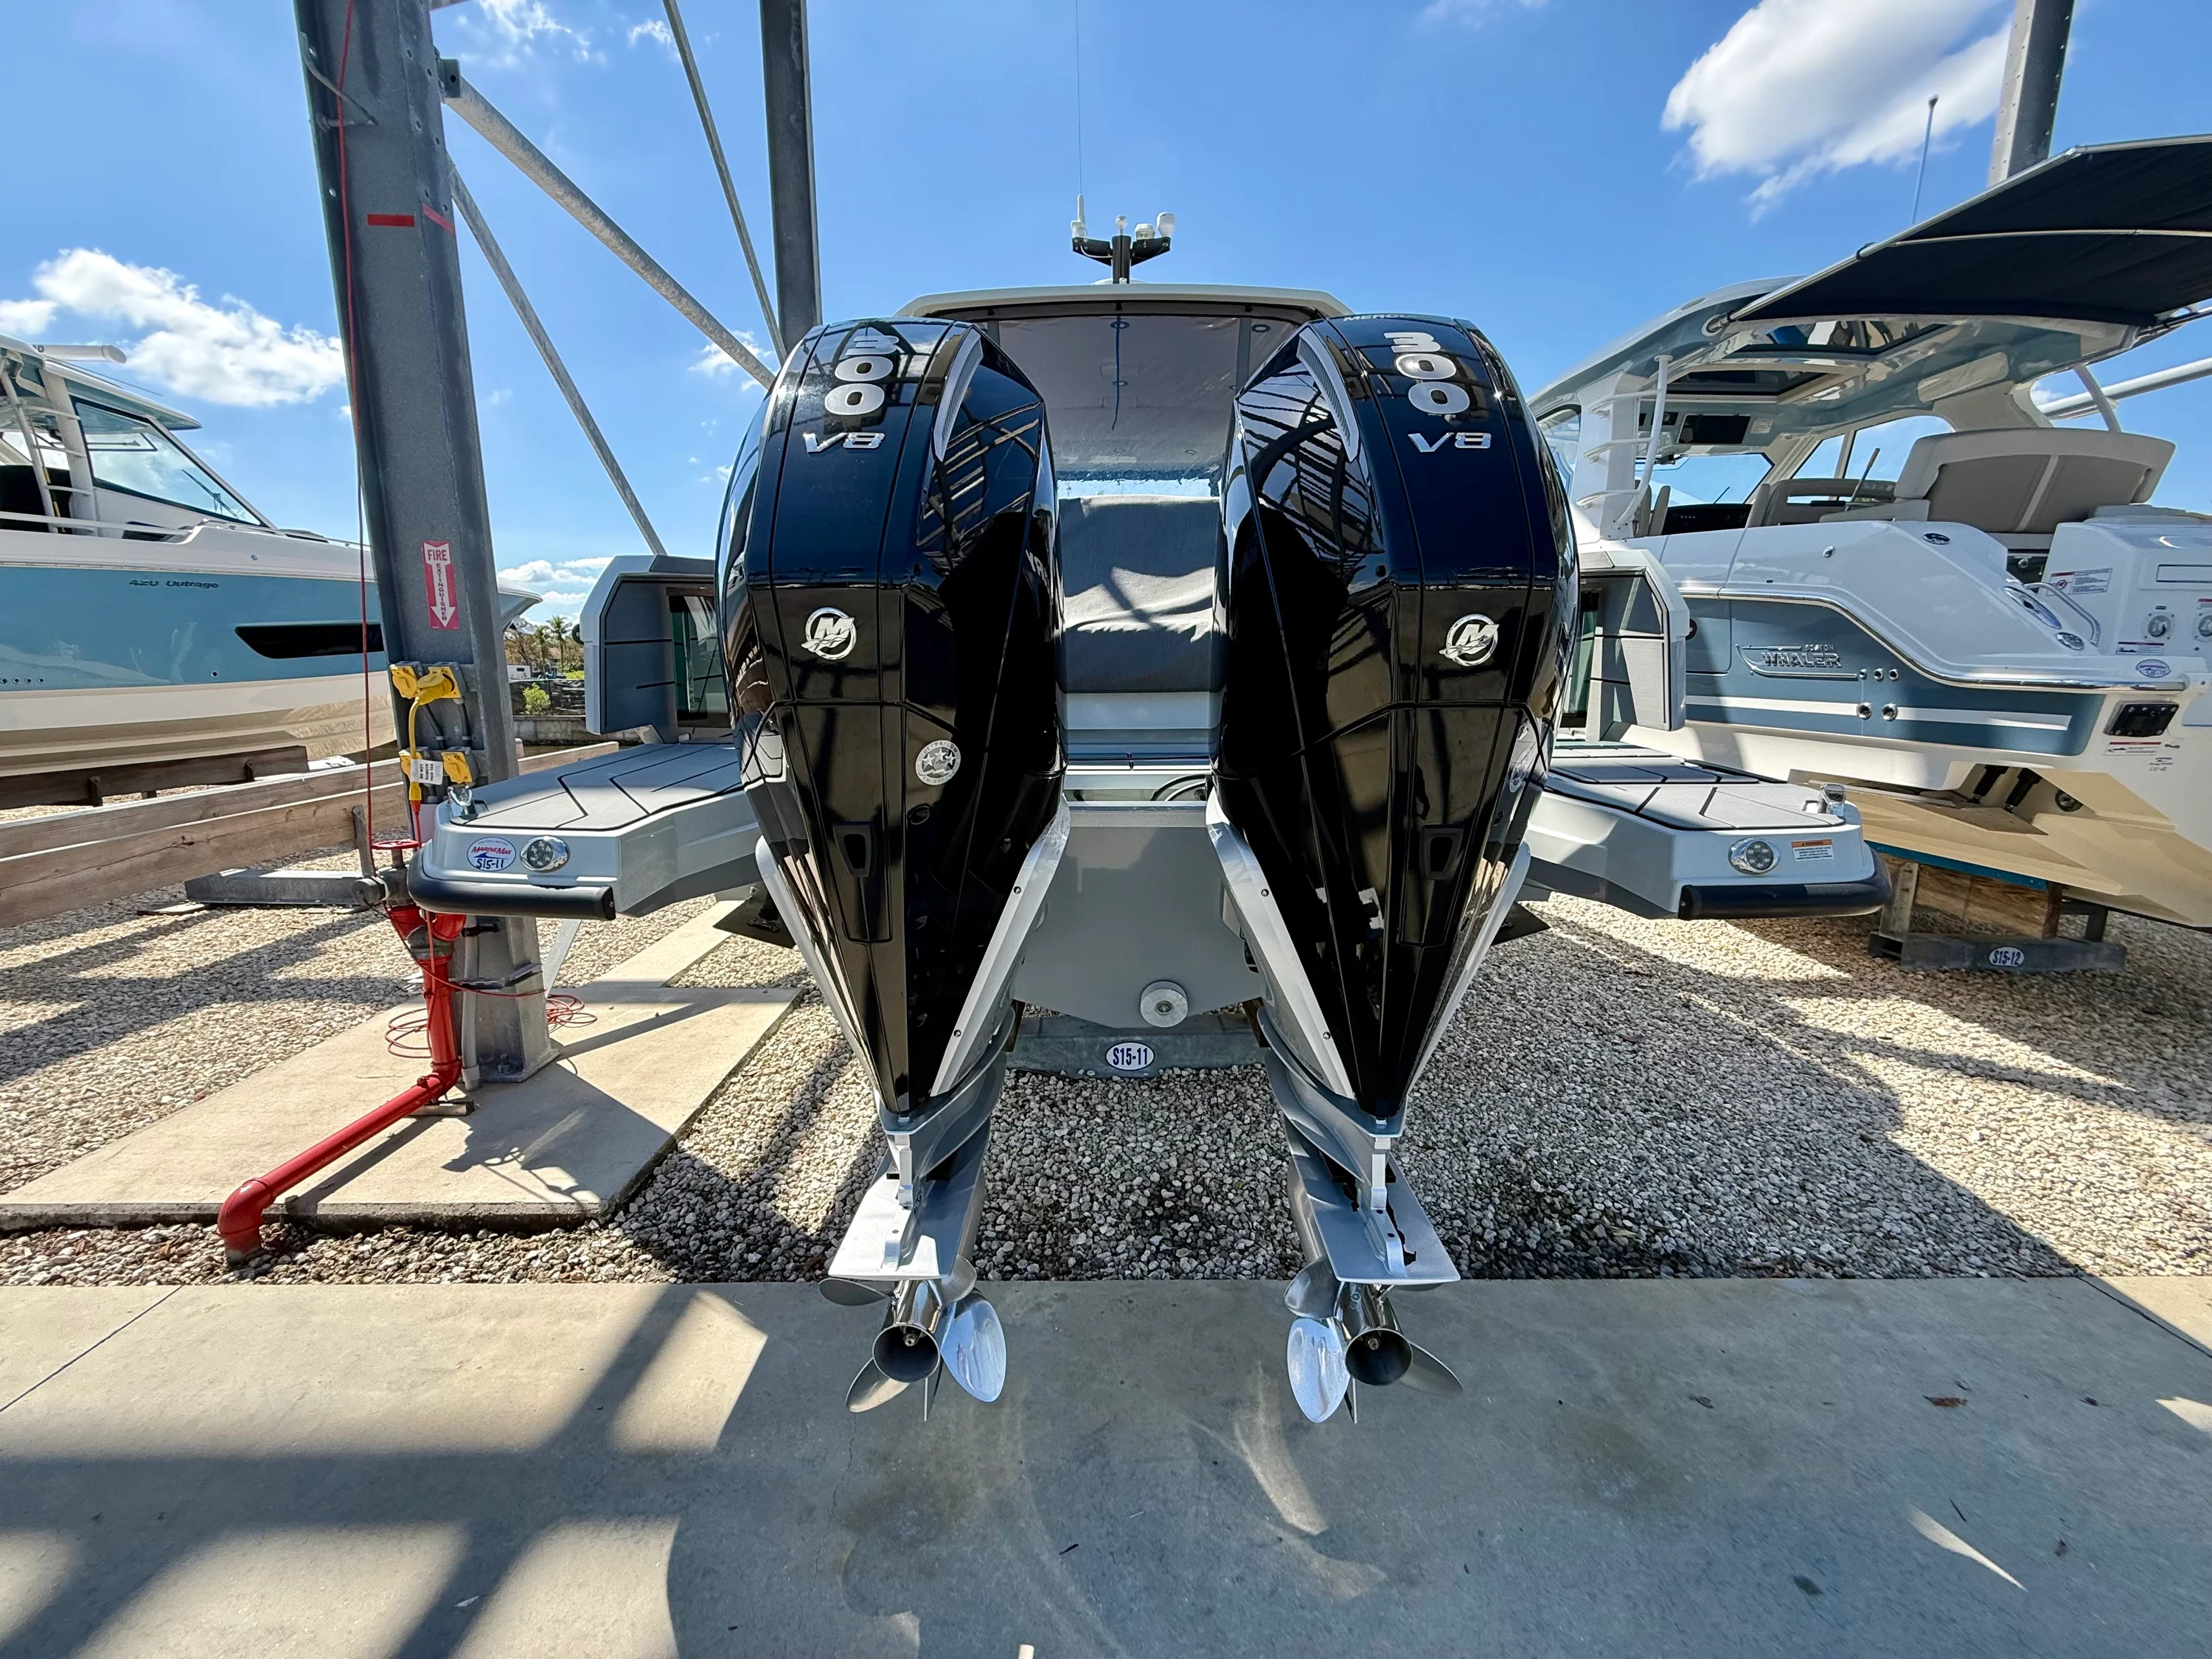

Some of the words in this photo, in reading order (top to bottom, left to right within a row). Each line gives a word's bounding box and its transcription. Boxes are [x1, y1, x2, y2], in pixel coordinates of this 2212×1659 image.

[824, 335, 900, 415] 300
[1383, 332, 1470, 414] 300
[803, 432, 885, 453] V8
[1408, 432, 1492, 453] V8
[427, 549, 448, 561] FIRE
[166, 580, 220, 589] Outrage
[436, 563, 448, 621] EXTINGUISHER
[1760, 652, 1842, 667] WHALER
[476, 858, 504, 869] S15-11
[1992, 950, 2021, 966] S15-12
[1113, 1047, 1147, 1065] S15-11
